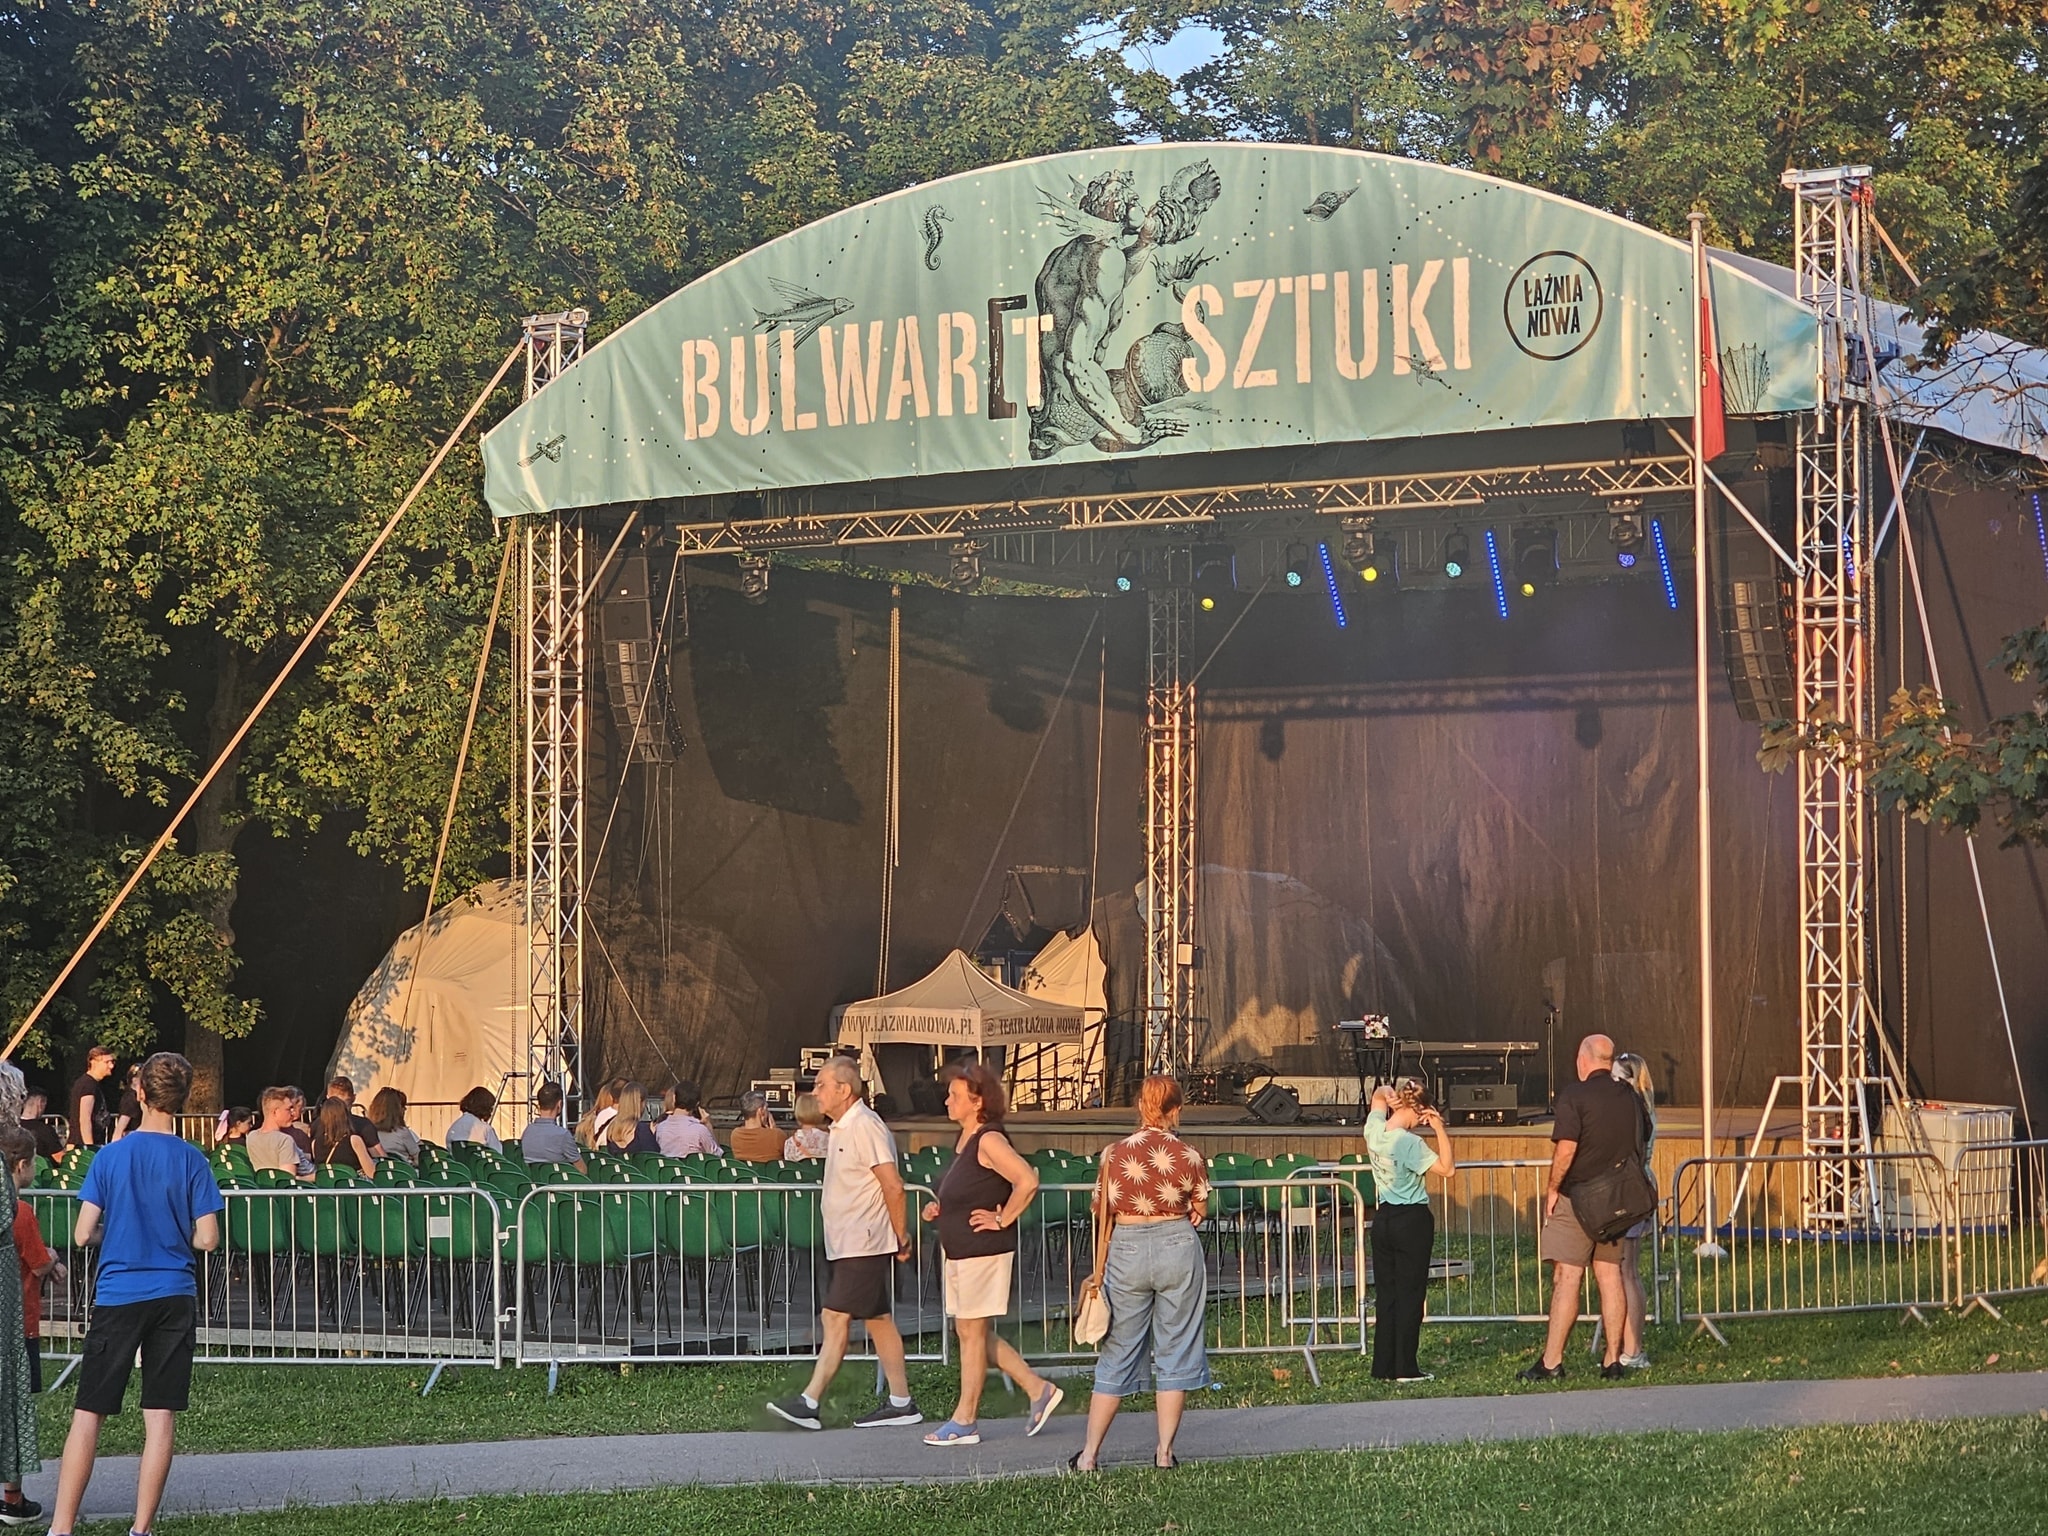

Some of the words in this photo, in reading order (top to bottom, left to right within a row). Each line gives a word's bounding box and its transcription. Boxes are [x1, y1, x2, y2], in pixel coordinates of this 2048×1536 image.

[1523, 273, 1583, 307] ŁAŹNIA
[1181, 256, 1472, 393] SZTUKI
[1527, 306, 1581, 338] NOWA
[999, 1018, 1023, 1035] TEATR
[1056, 1018, 1080, 1034] NOWA
